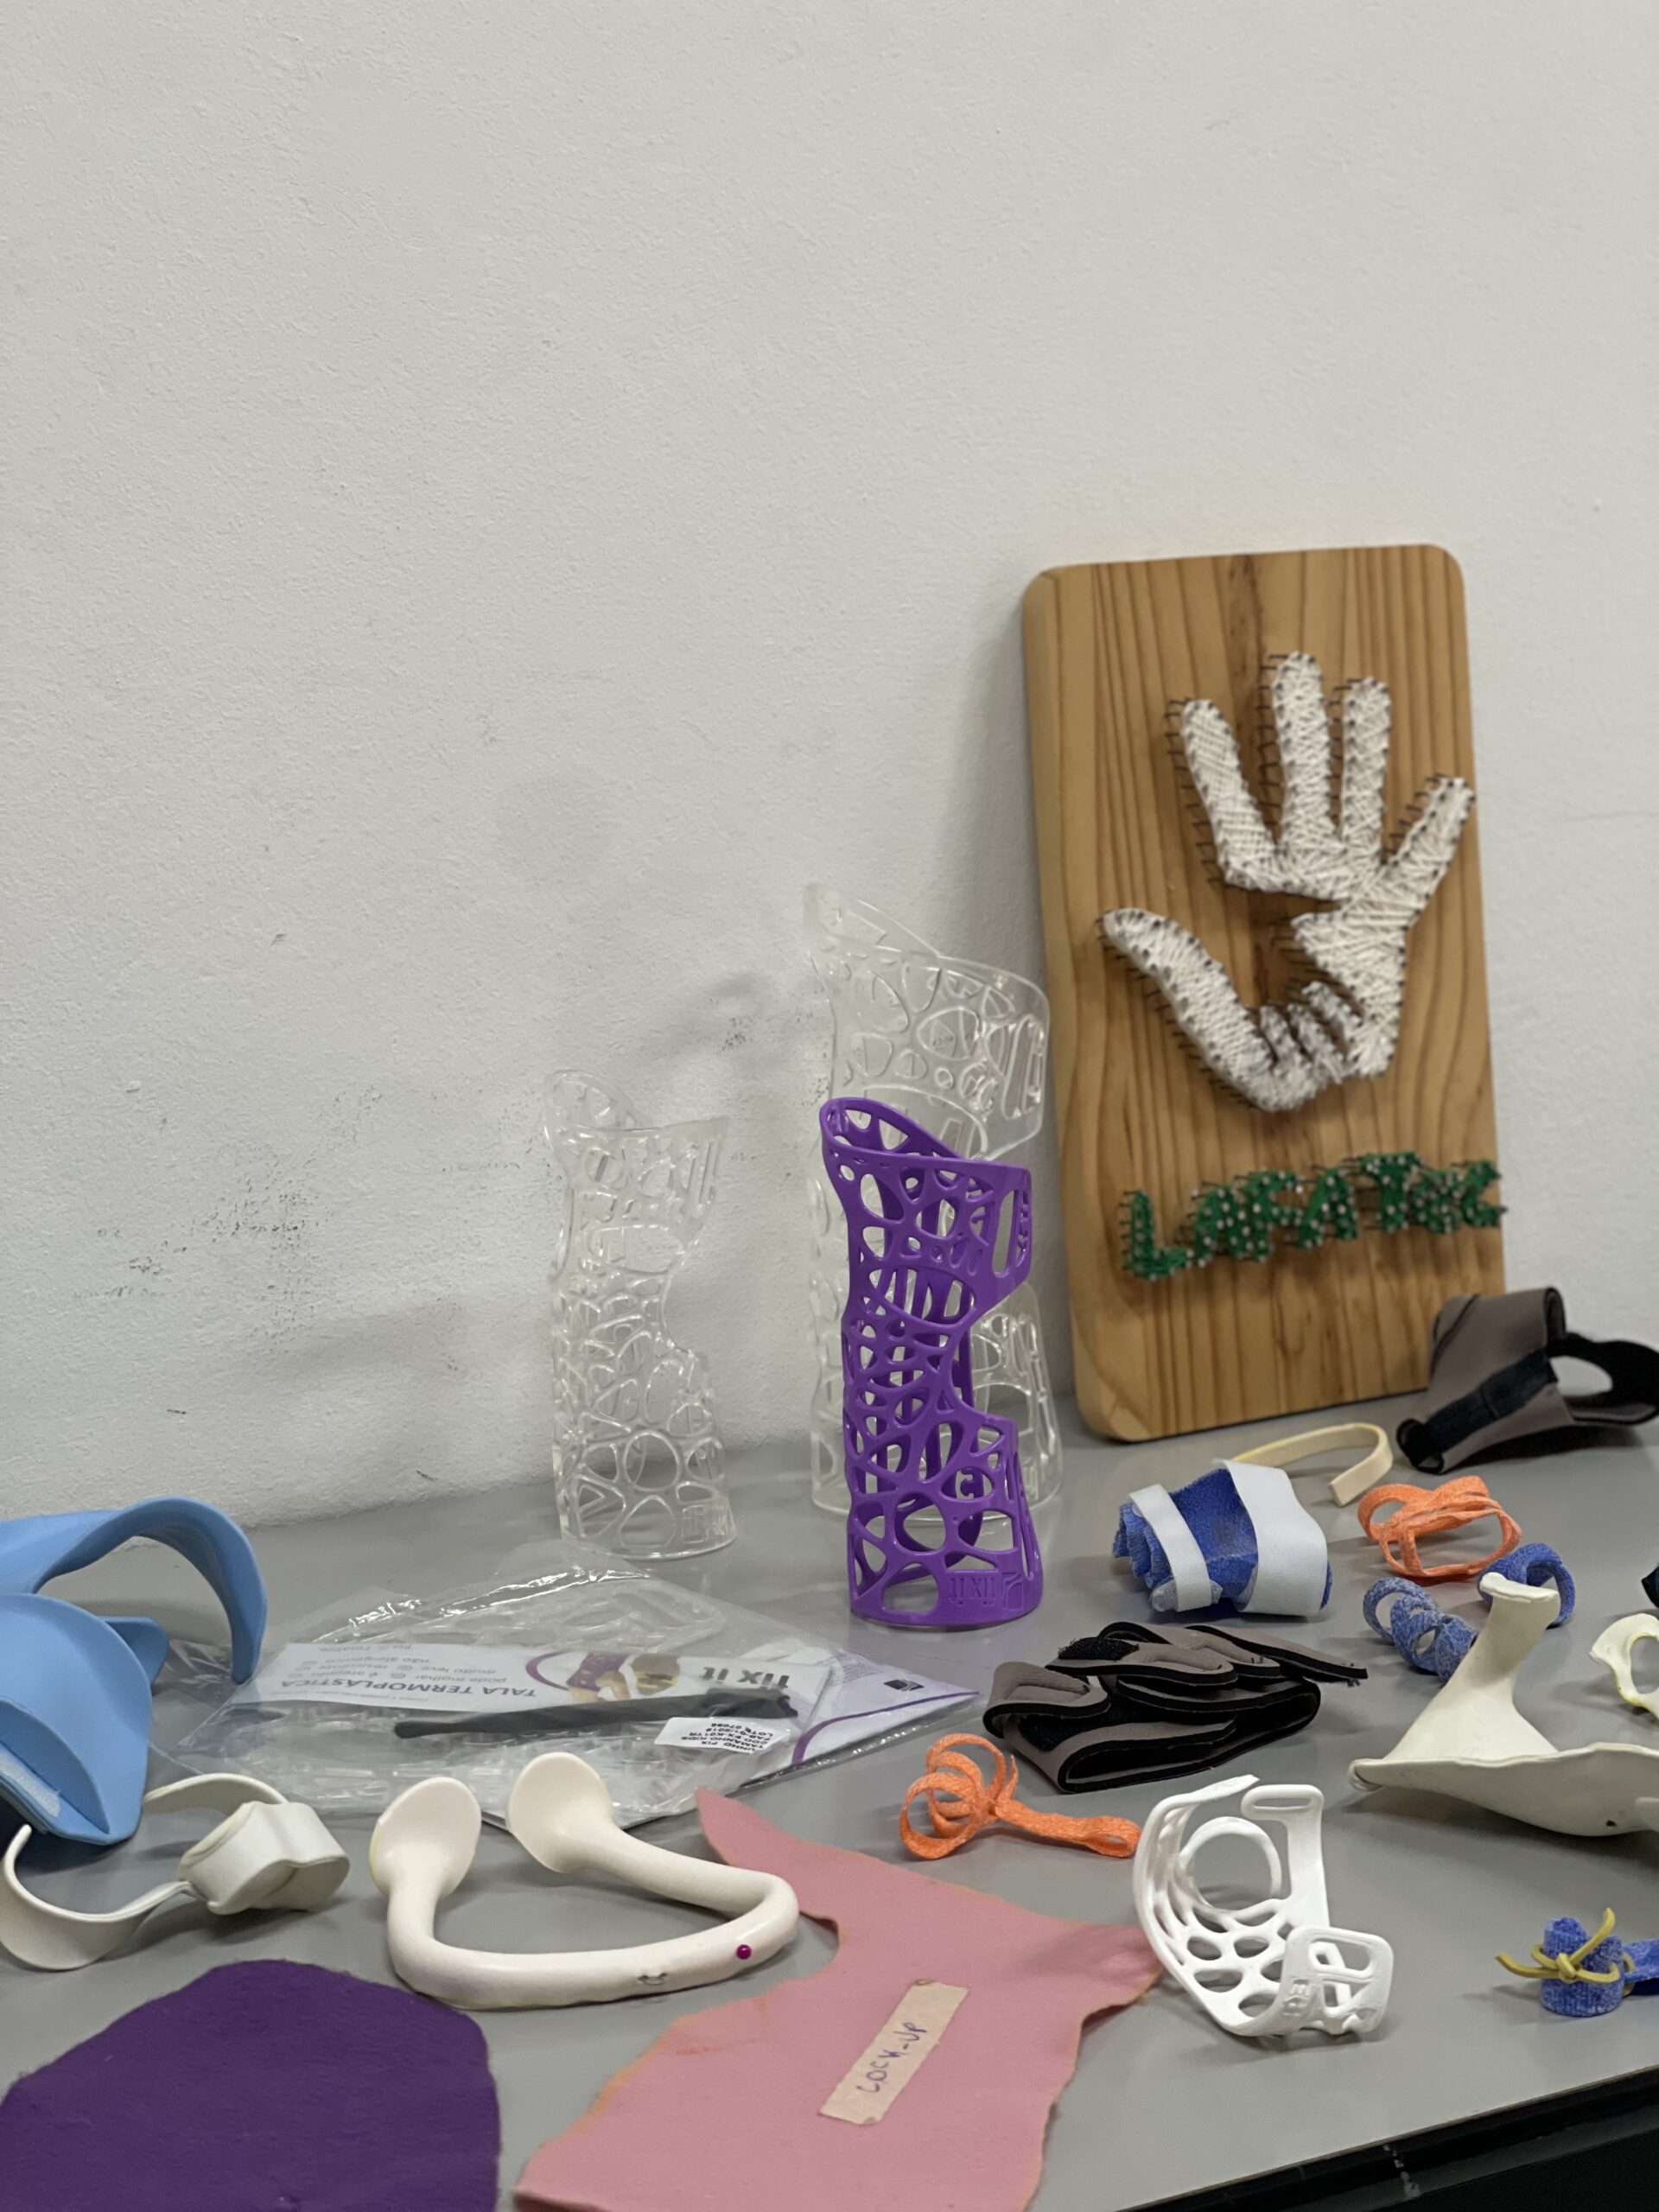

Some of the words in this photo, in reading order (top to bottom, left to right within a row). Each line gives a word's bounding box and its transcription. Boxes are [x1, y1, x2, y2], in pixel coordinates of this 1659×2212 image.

[698, 1666, 730, 1686] it
[738, 1669, 791, 1692] fix
[281, 1678, 474, 1695] TERMOPLÁSTICA
[481, 1686, 537, 1698] TALA
[709, 1737, 764, 1749] TAMANHO
